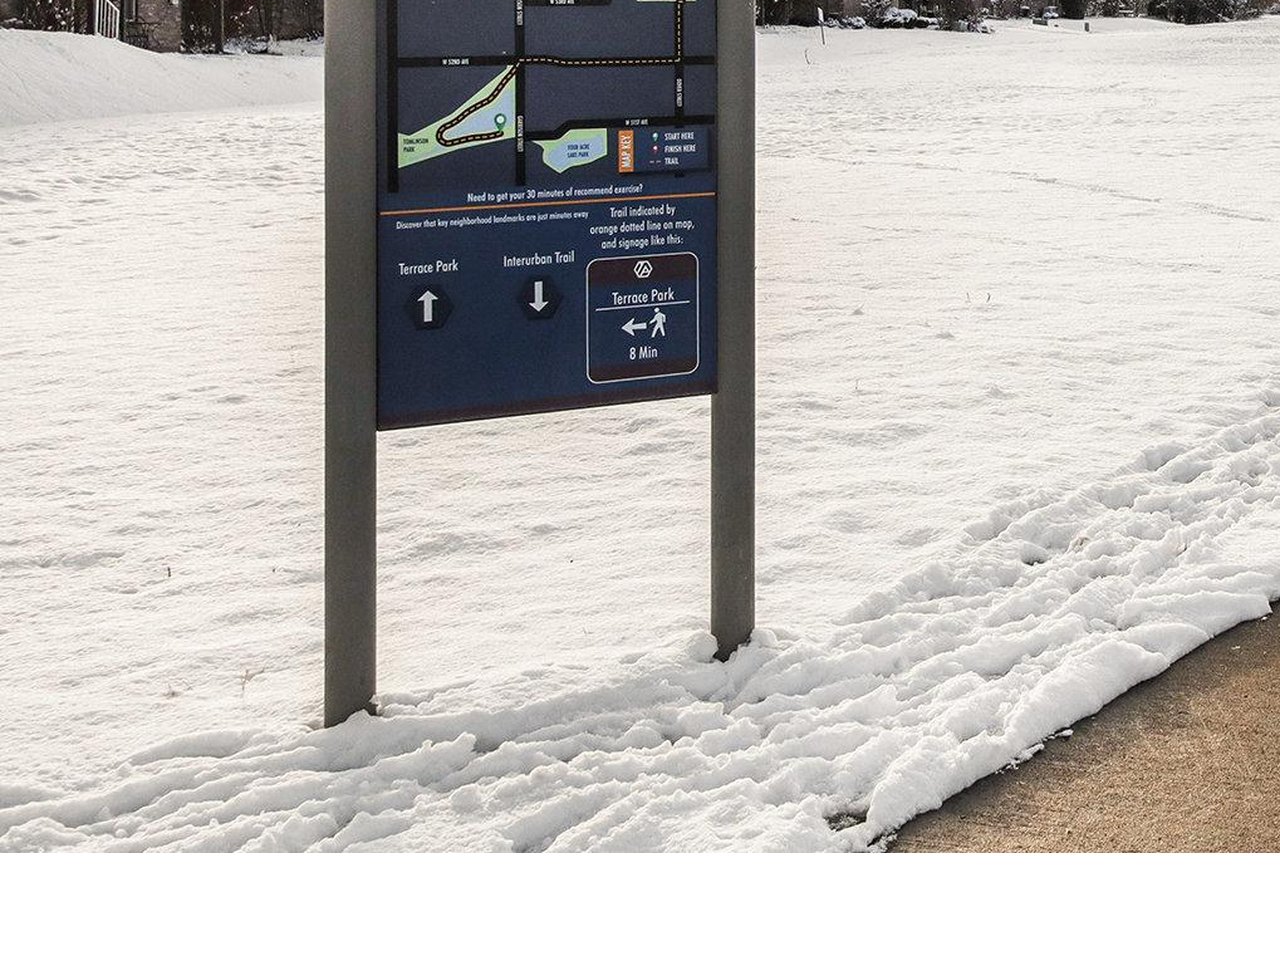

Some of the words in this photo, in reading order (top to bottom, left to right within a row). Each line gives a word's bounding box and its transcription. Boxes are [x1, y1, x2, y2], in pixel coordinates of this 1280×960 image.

[621, 135, 631, 150] KEY
[664, 133, 680, 141] START
[681, 132, 695, 140] HERE
[664, 145, 682, 153] FINISH
[621, 151, 631, 168] MAP
[665, 157, 679, 165] TRAIL
[467, 192, 486, 202] Need
[487, 193, 495, 201] to
[496, 193, 508, 203] get
[509, 193, 525, 202] your
[526, 190, 536, 199] 30
[537, 189, 564, 199] minutes
[566, 187, 573, 197] of
[574, 184, 613, 196] recommend
[614, 183, 644, 194] exercise?
[610, 206, 627, 218] Trail
[629, 204, 664, 217] indicated
[666, 203, 676, 216] by
[396, 220, 422, 229] Discover
[423, 219, 437, 228] that
[437, 218, 449, 228] key
[450, 215, 492, 228] neighborhood
[493, 213, 526, 223] landmarks
[526, 214, 536, 222] are
[537, 212, 549, 222] just
[549, 212, 572, 220] minutes
[573, 212, 588, 220] away
[590, 224, 618, 235] orange
[620, 221, 645, 233] dotted
[647, 220, 661, 231] line
[663, 222, 673, 230] on
[675, 220, 695, 230] map,
[601, 238, 617, 249] and
[618, 236, 649, 250] signage
[651, 235, 665, 246] like
[667, 233, 684, 244] this:
[503, 253, 552, 267] Interurban
[554, 250, 575, 264] Trail
[399, 262, 433, 275] Terrace
[436, 259, 459, 272] Park
[612, 291, 648, 305] Terrace
[651, 287, 675, 301] Park
[629, 347, 636, 360] 8
[638, 346, 658, 359] Min
